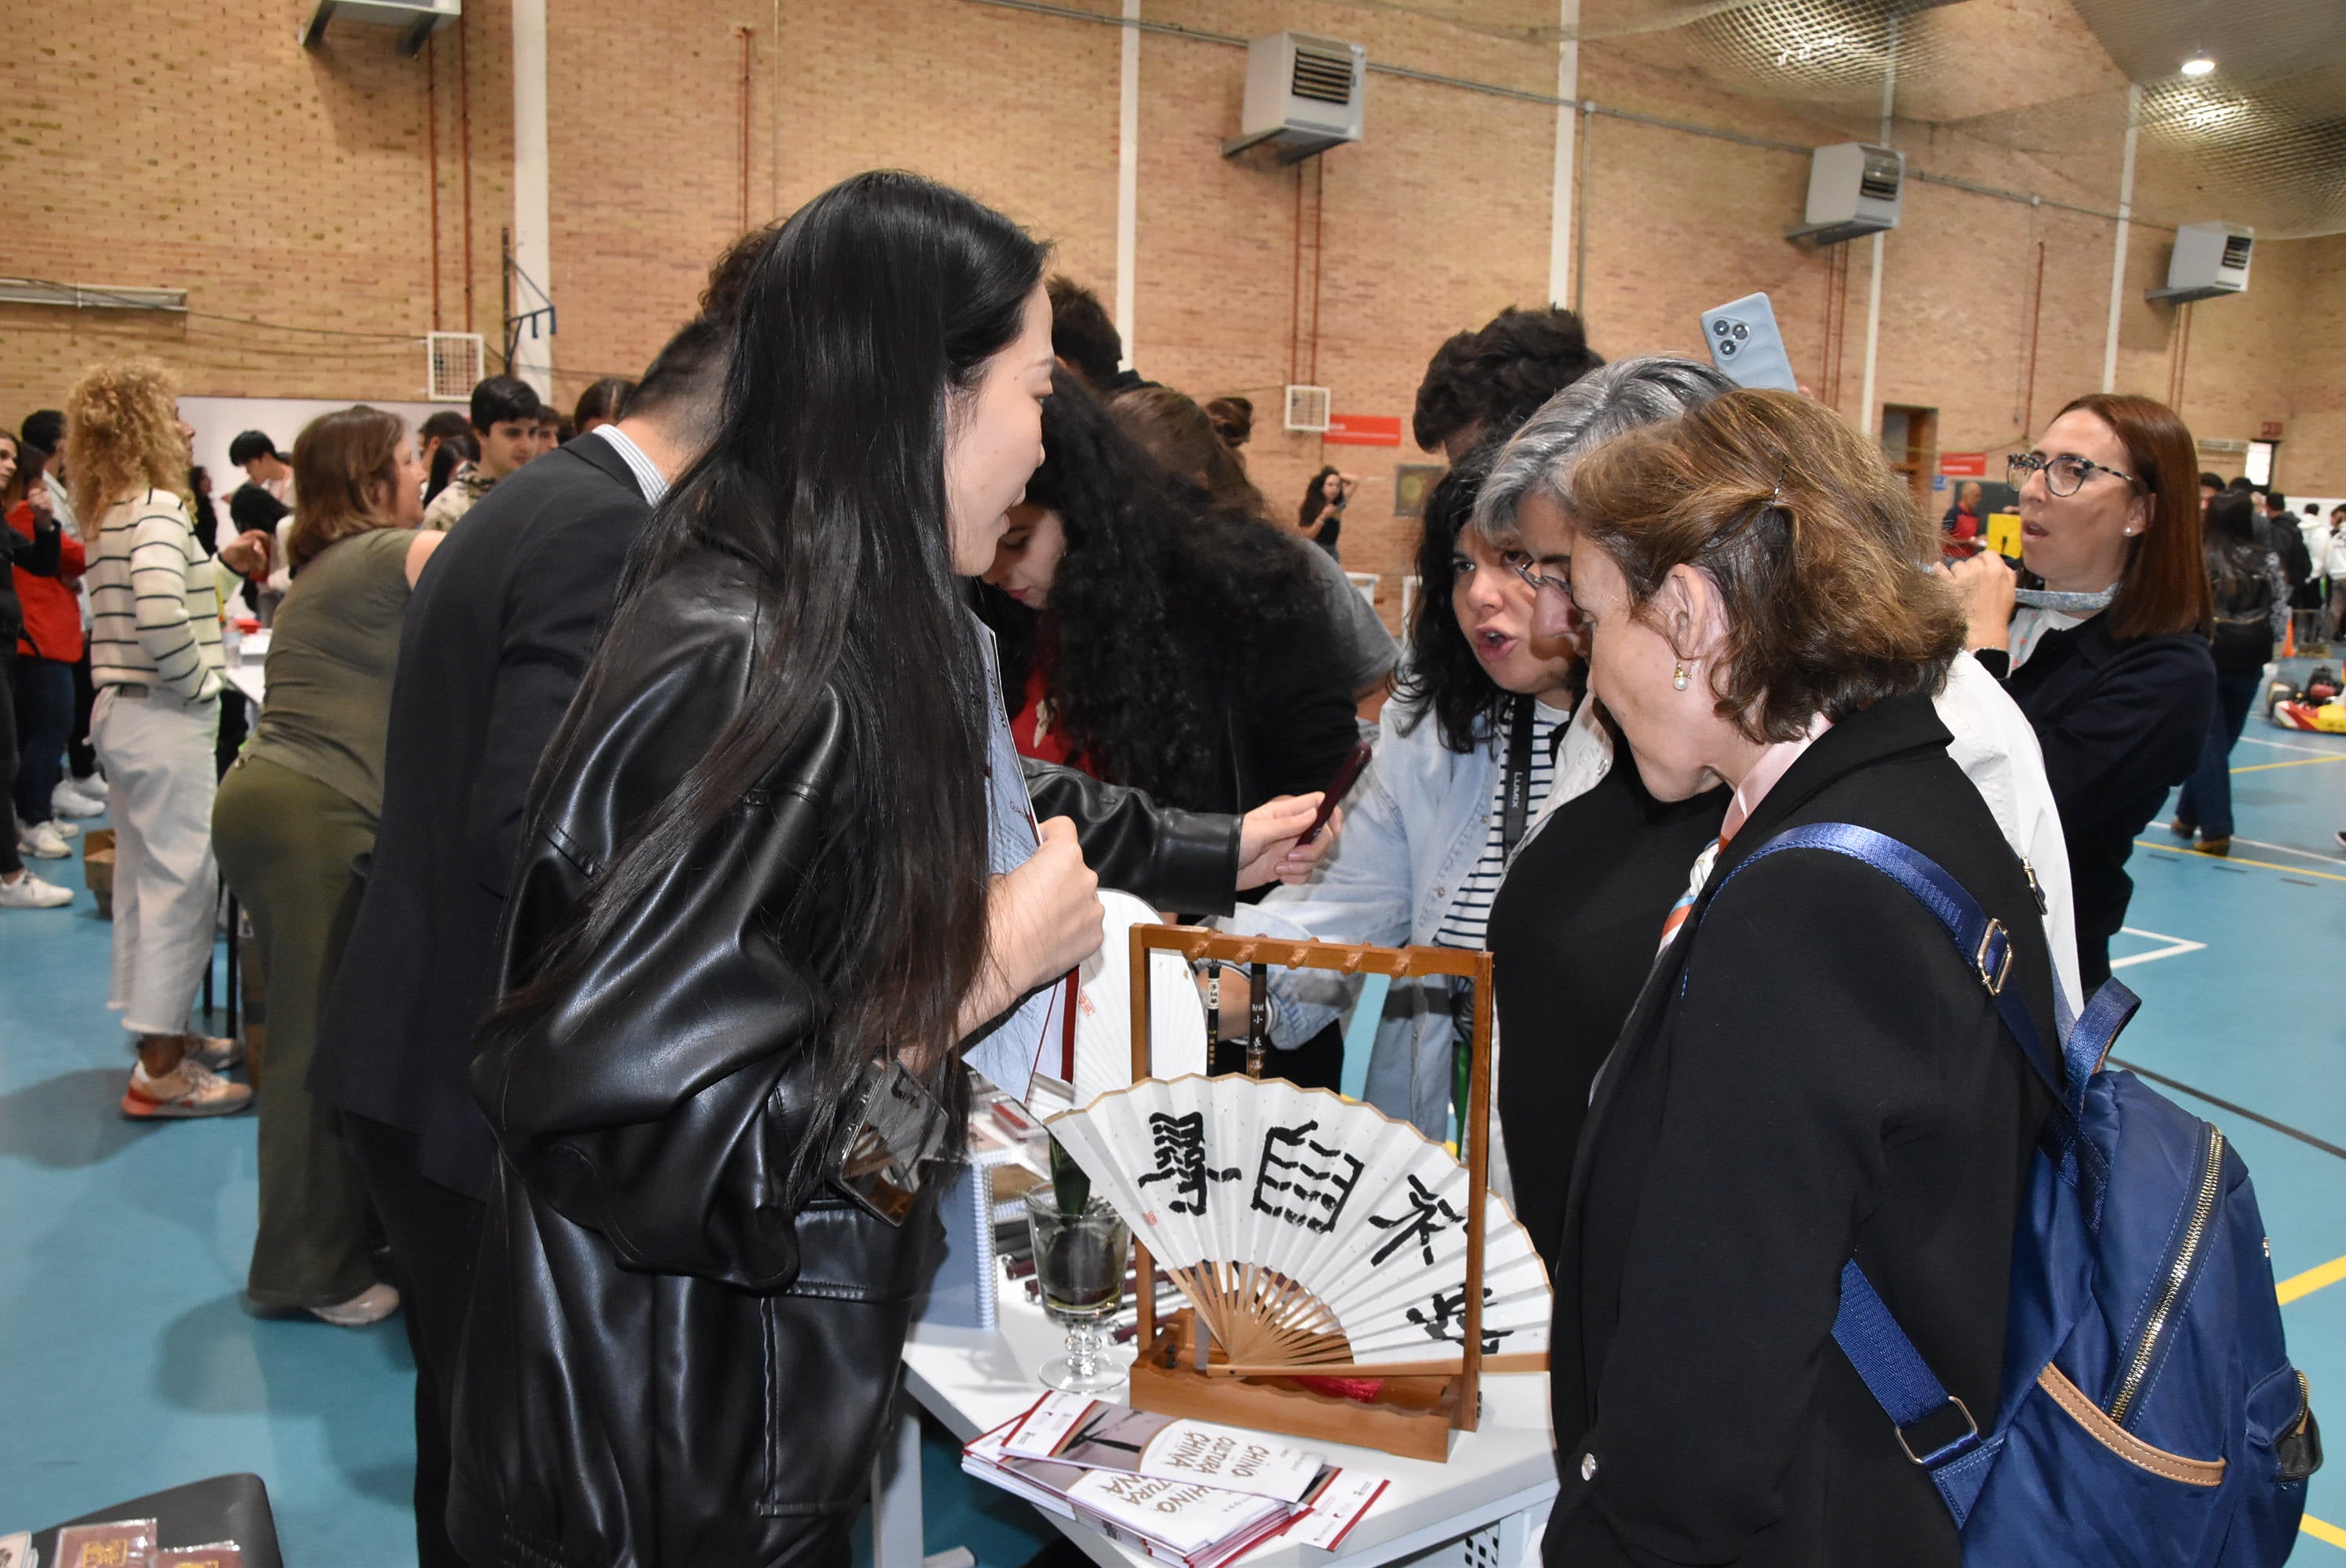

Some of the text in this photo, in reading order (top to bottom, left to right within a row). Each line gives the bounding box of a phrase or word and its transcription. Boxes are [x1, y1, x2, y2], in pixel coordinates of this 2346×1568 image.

[1512, 771, 1523, 809] LUMIX
[1162, 1430, 1211, 1468] CHINA
[1196, 1435, 1237, 1475] CULTURA
[1231, 1444, 1271, 1478] CHINO
[1120, 1477, 1173, 1505] TURA
[1156, 1486, 1215, 1513] HINO
